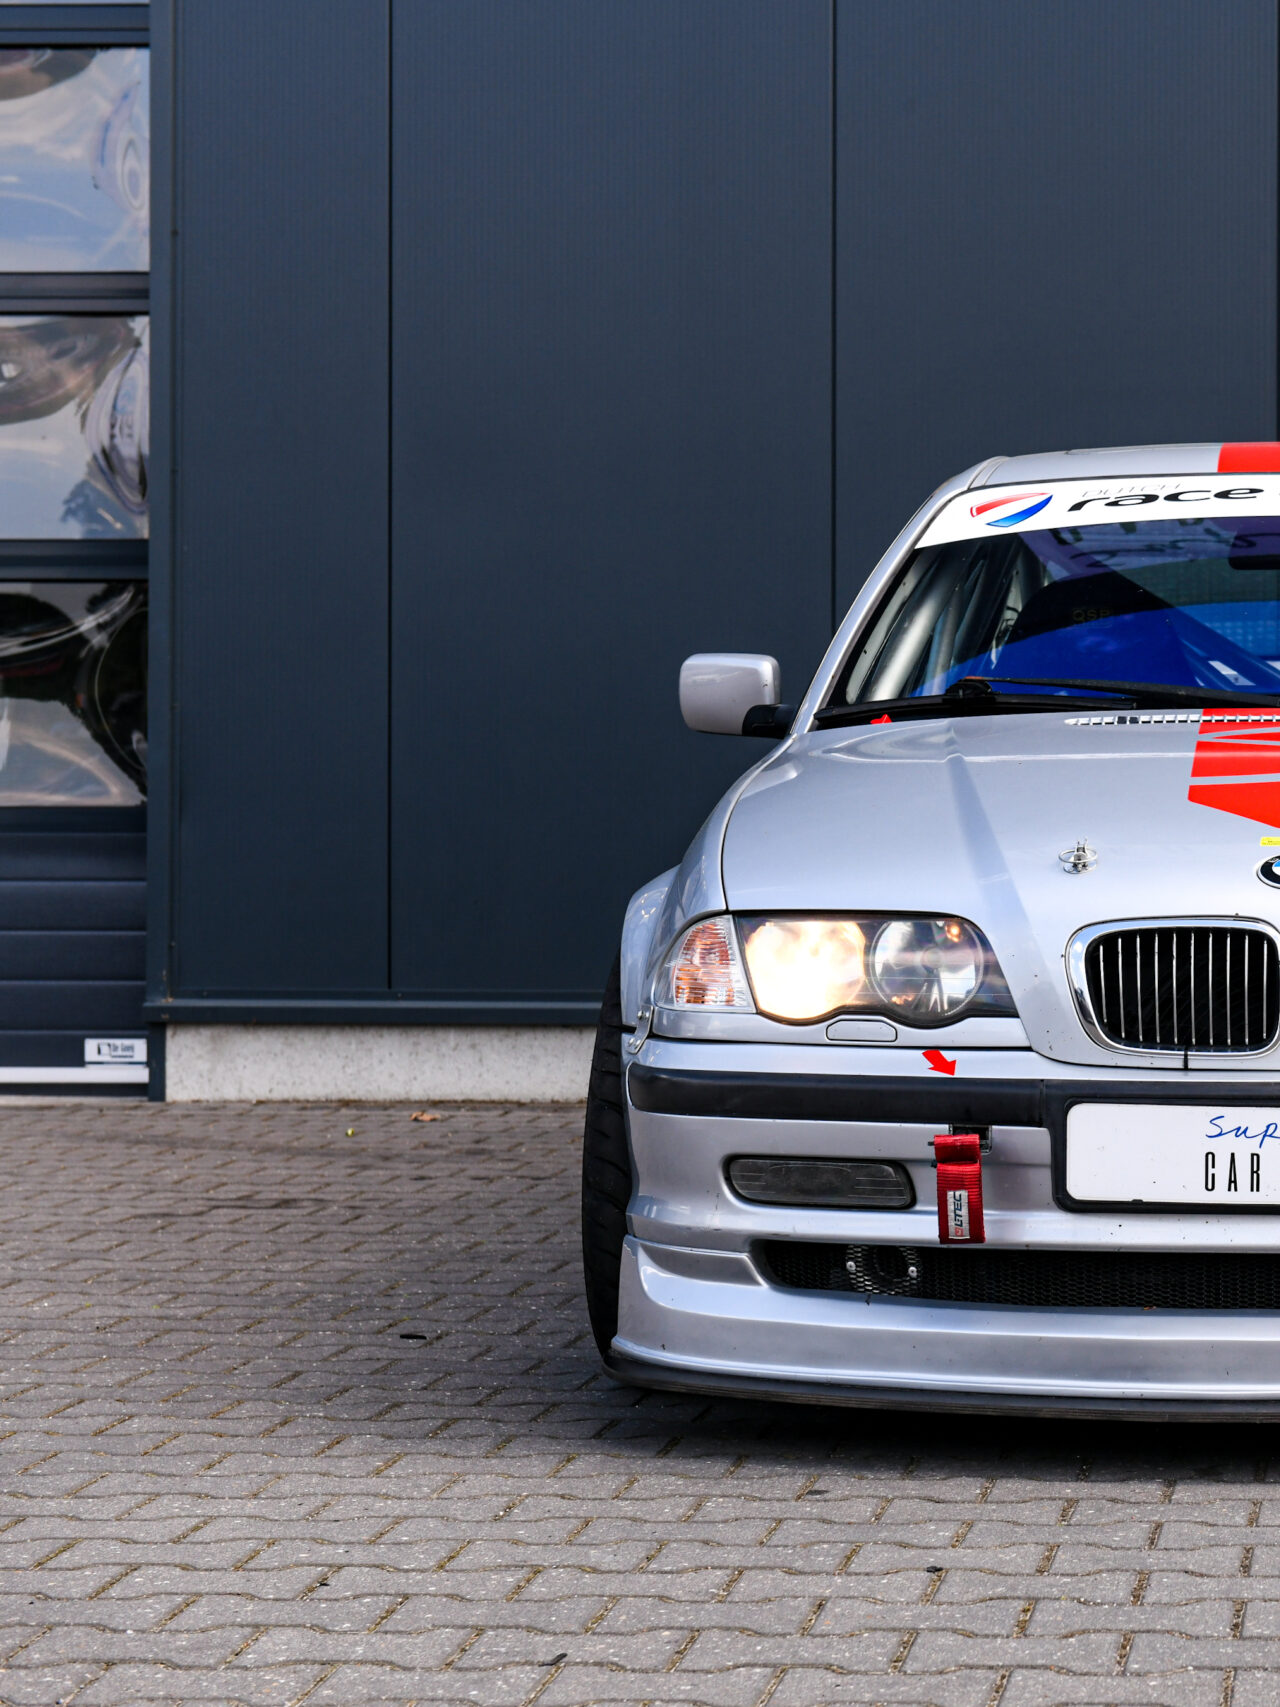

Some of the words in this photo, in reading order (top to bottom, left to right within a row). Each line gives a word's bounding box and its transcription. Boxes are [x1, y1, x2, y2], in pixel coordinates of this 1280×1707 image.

[1067, 487, 1264, 512] race
[1082, 483, 1181, 497] DUTCH
[1204, 1151, 1261, 1192] CAR
